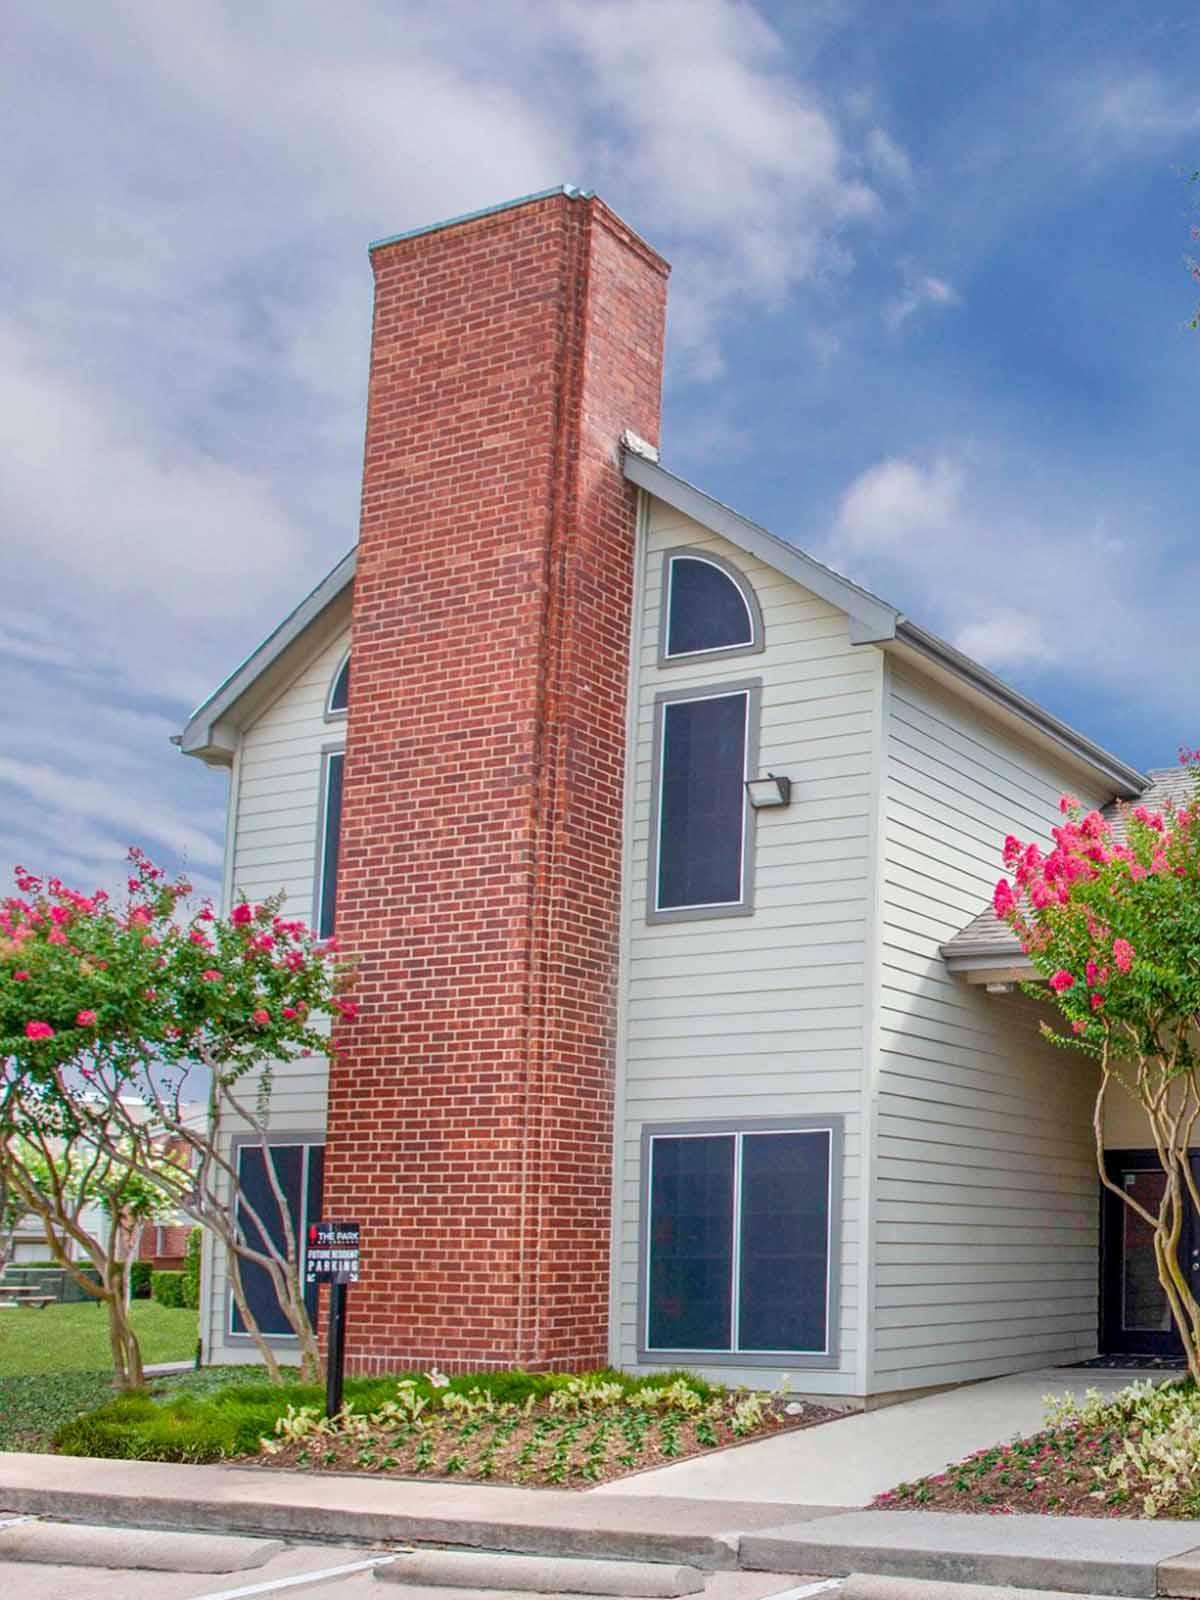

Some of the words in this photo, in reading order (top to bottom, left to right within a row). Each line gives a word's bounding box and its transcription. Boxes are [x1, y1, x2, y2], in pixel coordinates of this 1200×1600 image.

[318, 1232, 336, 1241] THE
[336, 1232, 359, 1241] PARK
[308, 1260, 359, 1272] PARKING
